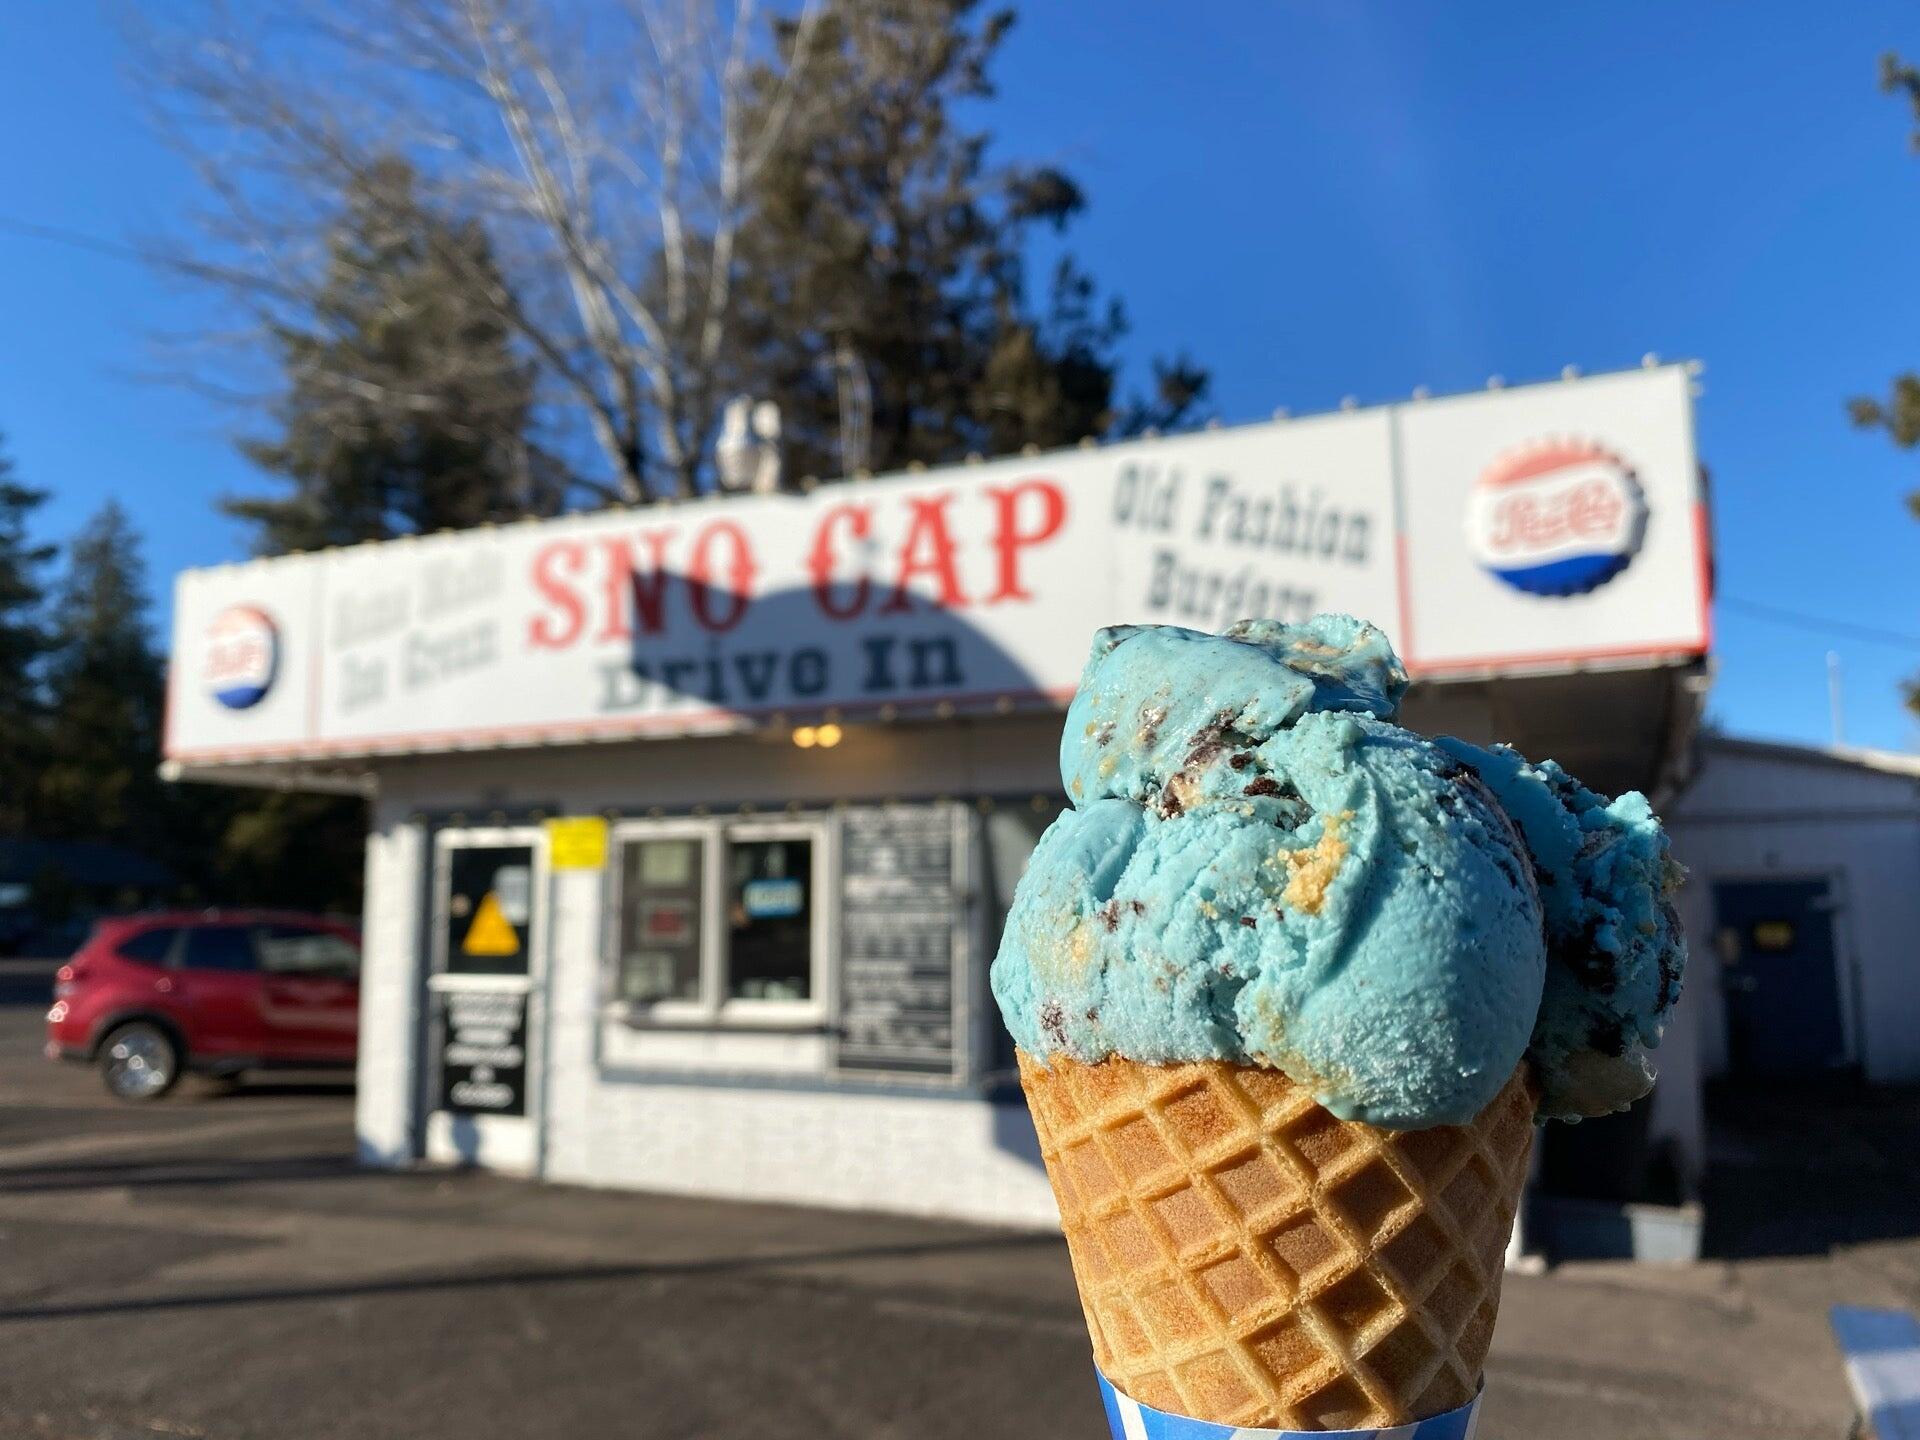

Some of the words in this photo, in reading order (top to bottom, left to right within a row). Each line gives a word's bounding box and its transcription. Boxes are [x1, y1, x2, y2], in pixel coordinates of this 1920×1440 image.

[529, 518, 757, 650] SNO
[808, 477, 1067, 621] CAP
[1112, 463, 1184, 530] Old
[1196, 476, 1371, 565] Fashion
[601, 635, 828, 709] Drive
[861, 631, 964, 689] In
